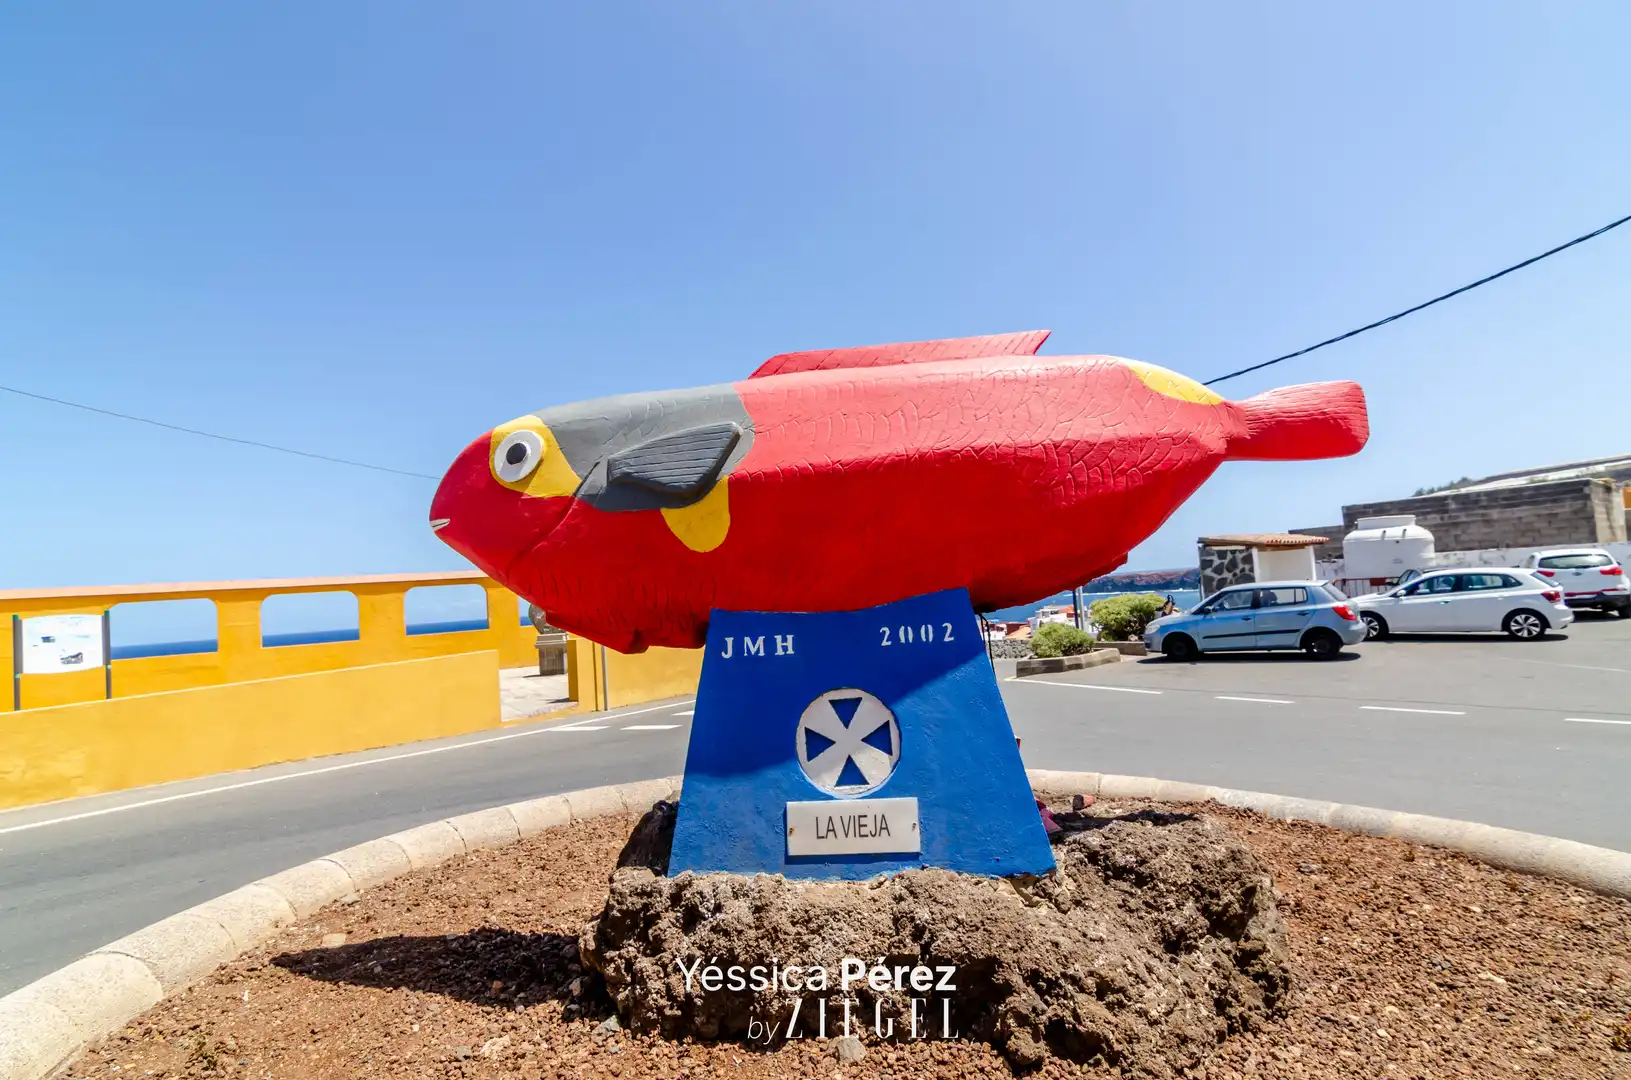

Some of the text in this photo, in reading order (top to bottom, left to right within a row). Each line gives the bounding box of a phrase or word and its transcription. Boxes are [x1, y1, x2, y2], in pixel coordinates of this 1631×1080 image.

[879, 622, 955, 646] 2002
[815, 813, 891, 840] LA VIEJA
